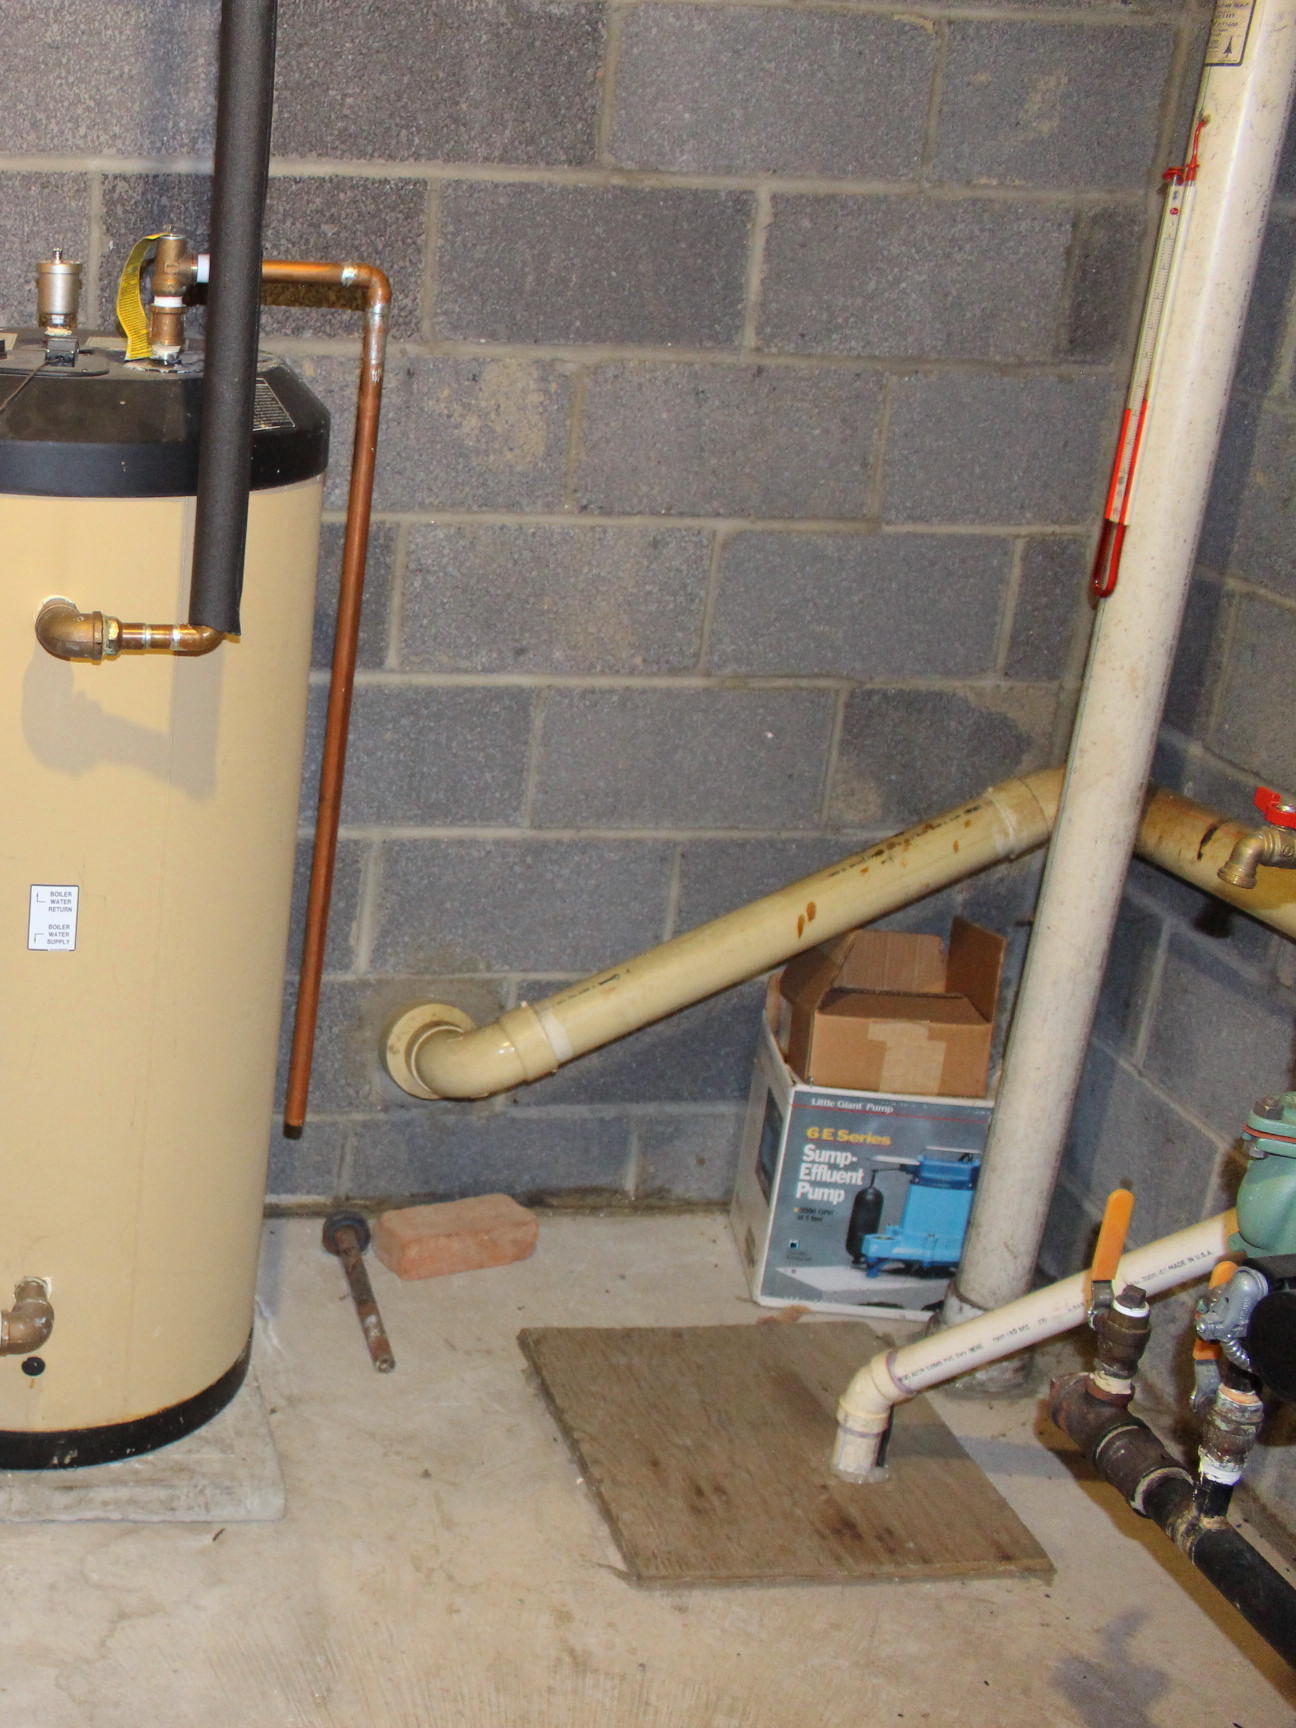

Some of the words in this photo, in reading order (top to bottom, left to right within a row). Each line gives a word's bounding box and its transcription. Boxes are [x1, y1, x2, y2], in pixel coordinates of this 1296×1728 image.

[810, 1098, 835, 1108] Little
[836, 1099, 863, 1111] Giant
[865, 1103, 894, 1114] Pump
[836, 1129, 893, 1146] Series
[802, 1143, 858, 1168] Sump-
[798, 1162, 865, 1186] Effluent
[795, 1181, 846, 1206] Pump
